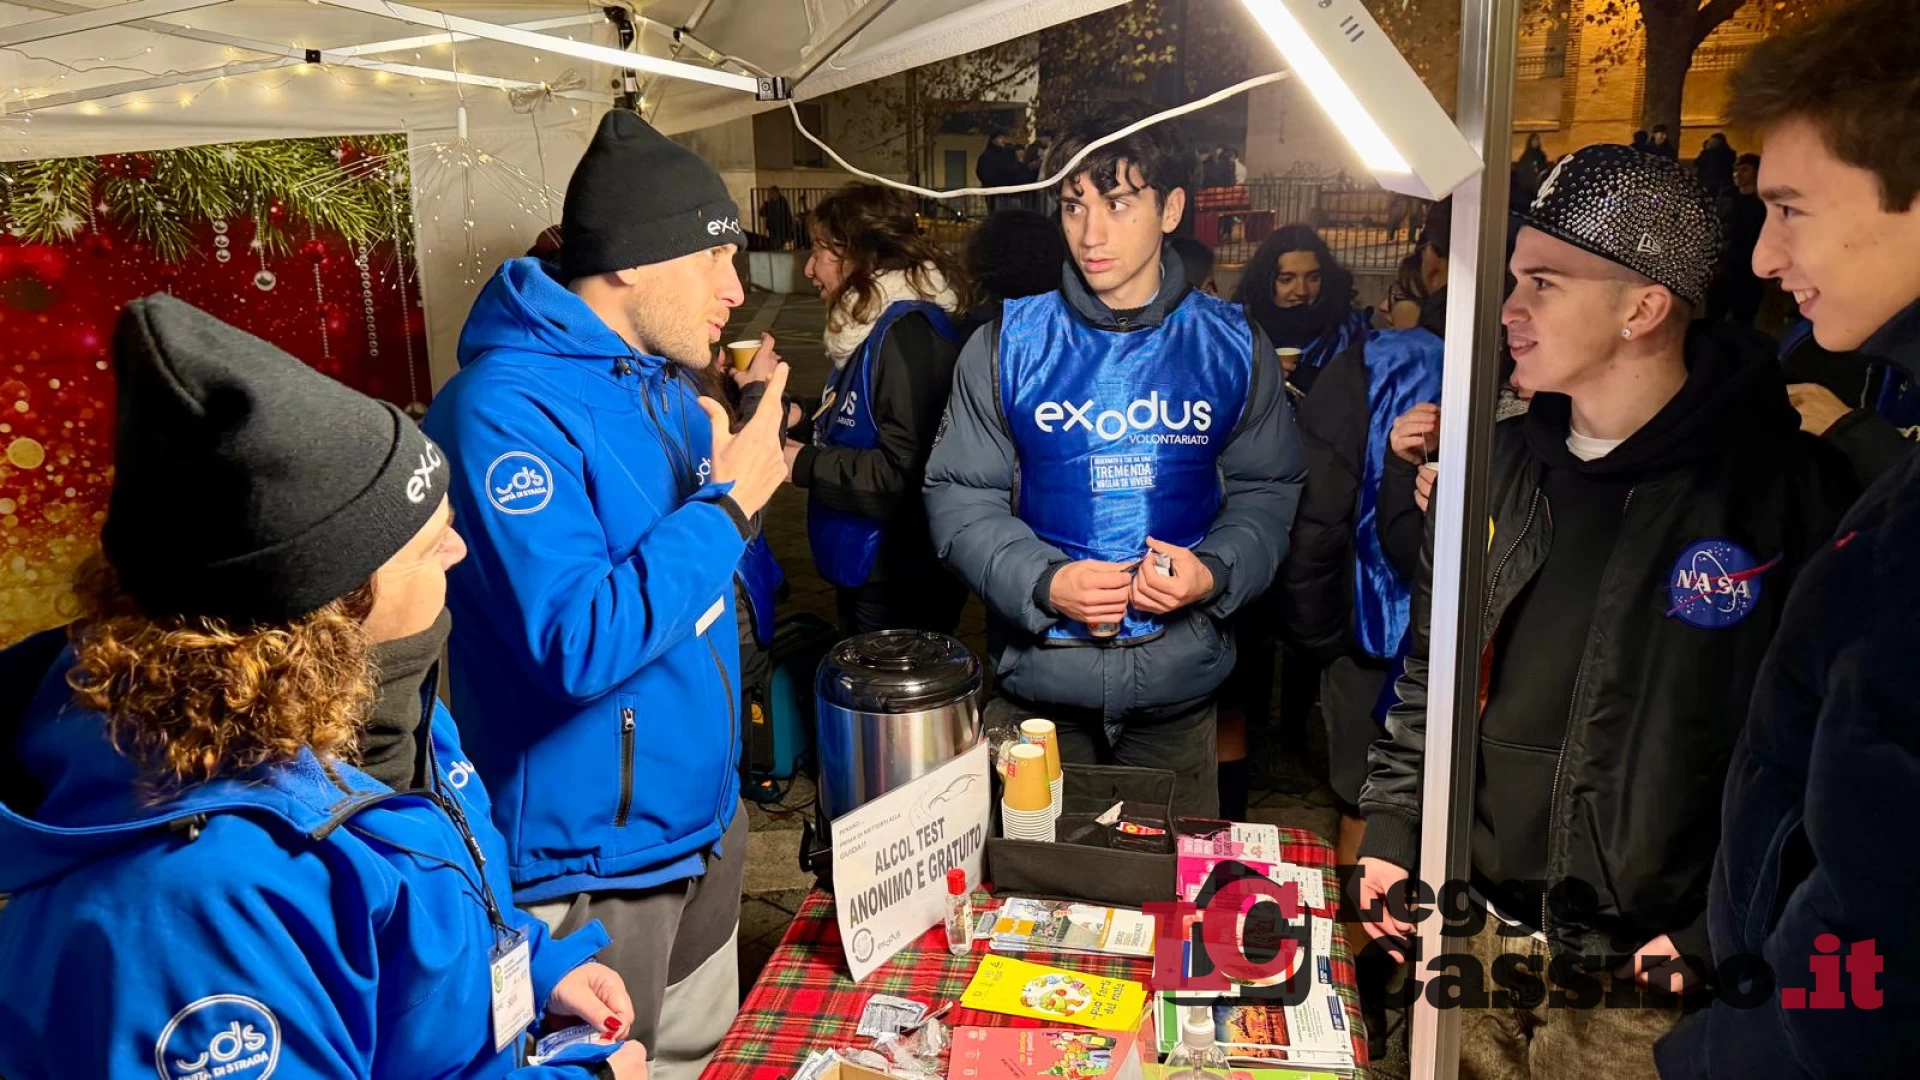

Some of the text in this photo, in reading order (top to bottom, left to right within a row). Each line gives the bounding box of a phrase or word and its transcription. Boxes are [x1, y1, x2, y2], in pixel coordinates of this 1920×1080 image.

[707, 216, 741, 236] exo
[1034, 390, 1212, 441] exodus
[1128, 433, 1209, 445] VOLONTARIATO
[407, 441, 442, 503] exo
[1094, 463, 1152, 479] TREMENDA
[1676, 569, 1752, 599] NASA
[874, 817, 945, 876] ALCOL TEST
[850, 822, 981, 930] ANONIMO E GRATUITO
[226, 1051, 270, 1074] STRADA
